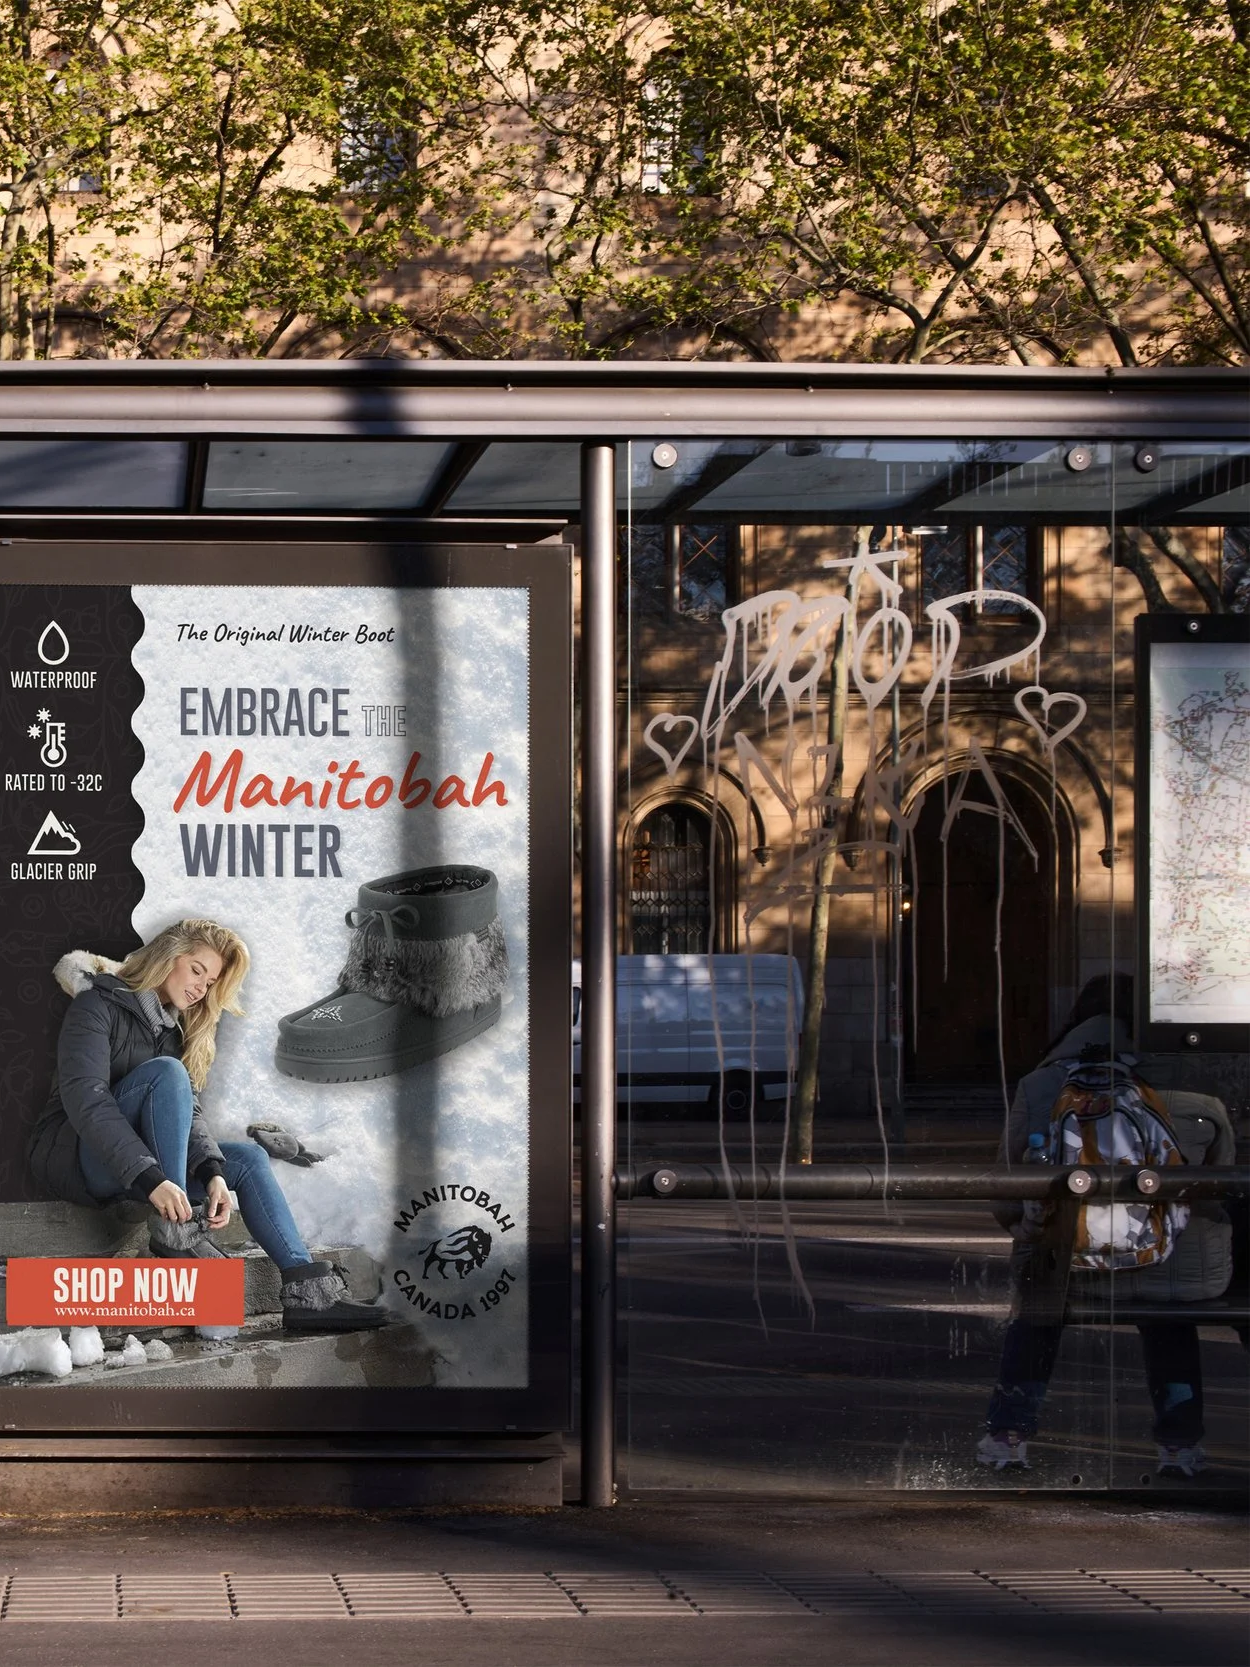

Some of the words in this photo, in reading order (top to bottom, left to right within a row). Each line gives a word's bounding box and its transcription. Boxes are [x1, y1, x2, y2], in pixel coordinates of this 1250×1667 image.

[177, 623, 209, 642] The
[213, 623, 285, 647] Original
[289, 624, 350, 643] Winter
[354, 624, 395, 644] Boot
[10, 670, 97, 689] WATERPROOF
[180, 687, 350, 737] EMBRACE
[361, 705, 407, 737] THE
[5, 773, 45, 791] RATED
[49, 773, 66, 792] TO
[70, 773, 103, 792] -32C
[173, 748, 509, 814] Manitobah
[179, 823, 343, 878] WINTER
[10, 862, 64, 880] GLACIER
[68, 862, 97, 881] GRIP
[394, 1184, 516, 1233] MANITOBAH
[53, 1267, 124, 1303] SHOP
[133, 1267, 199, 1303] NOW
[393, 1269, 476, 1319] CANADA
[479, 1268, 517, 1312] 1997
[54, 1302, 195, 1317] www.manitobah.ca
